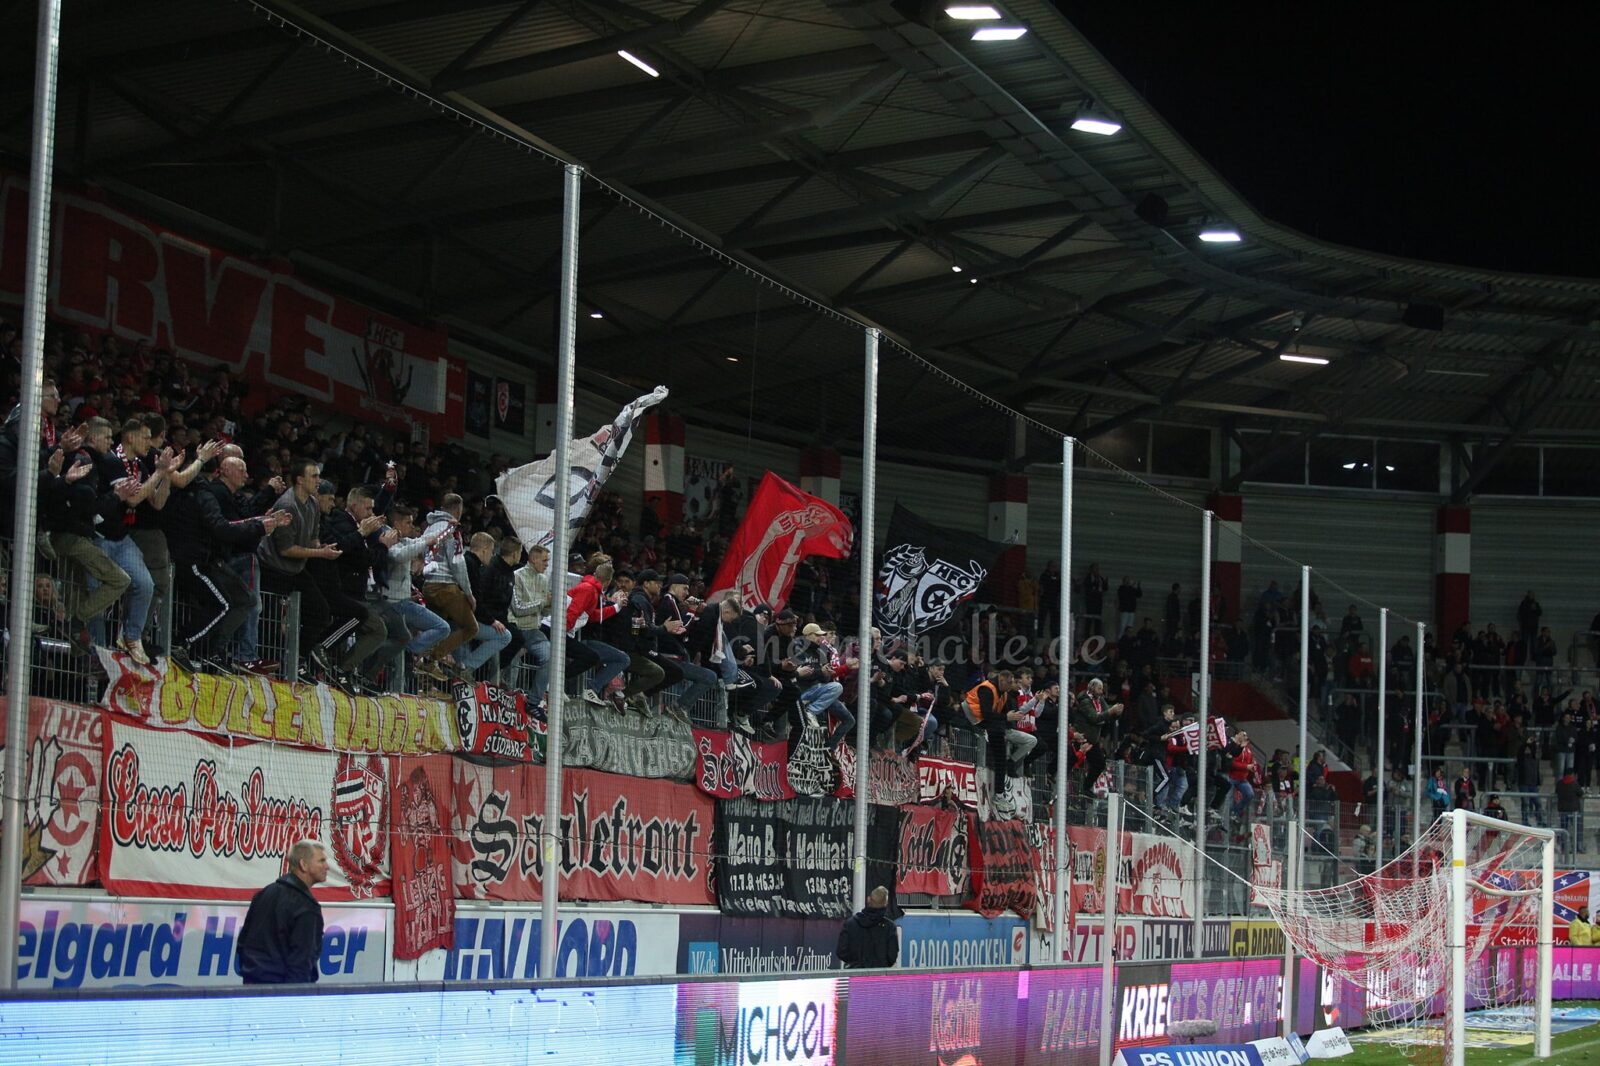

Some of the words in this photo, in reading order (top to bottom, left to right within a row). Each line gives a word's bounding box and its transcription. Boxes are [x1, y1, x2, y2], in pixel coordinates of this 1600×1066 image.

[936, 564, 971, 590] HFC
[728, 822, 761, 867] Mario
[796, 831, 845, 871] Matthias
[17, 910, 186, 987] elgard
[909, 939, 949, 968] RADIO
[954, 938, 1007, 966] BROCKEN
[1144, 924, 1184, 960] DELTA
[722, 947, 796, 974] Mitteldeutsche
[796, 946, 832, 971] Zeitung
[1552, 963, 1593, 982] ALLE
[1041, 986, 1100, 1052] HALL
[1139, 1051, 1172, 1066] PS
[1184, 1049, 1251, 1066] UNION
